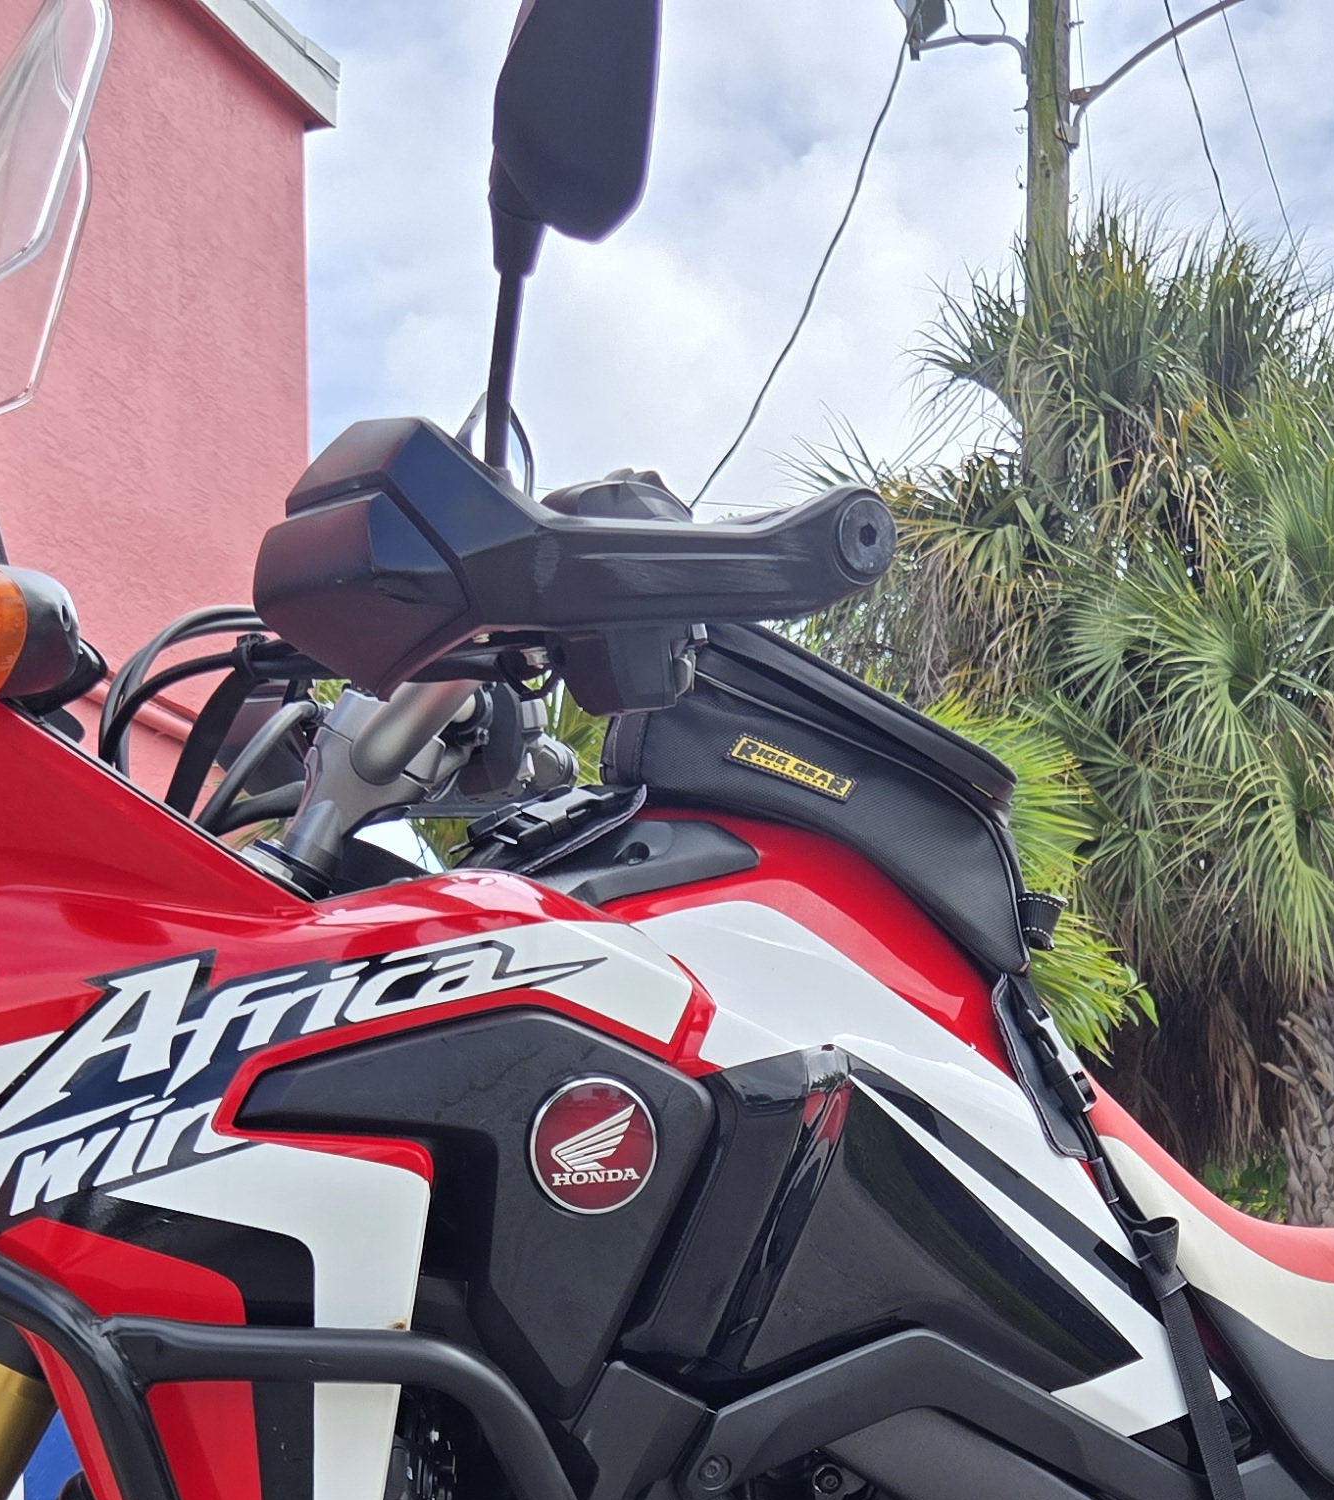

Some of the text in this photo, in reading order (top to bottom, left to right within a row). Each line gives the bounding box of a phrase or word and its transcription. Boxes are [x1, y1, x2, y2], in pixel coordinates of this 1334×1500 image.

[736, 740, 847, 793] RIGG GEAR
[552, 1168, 640, 1186] HONDA
